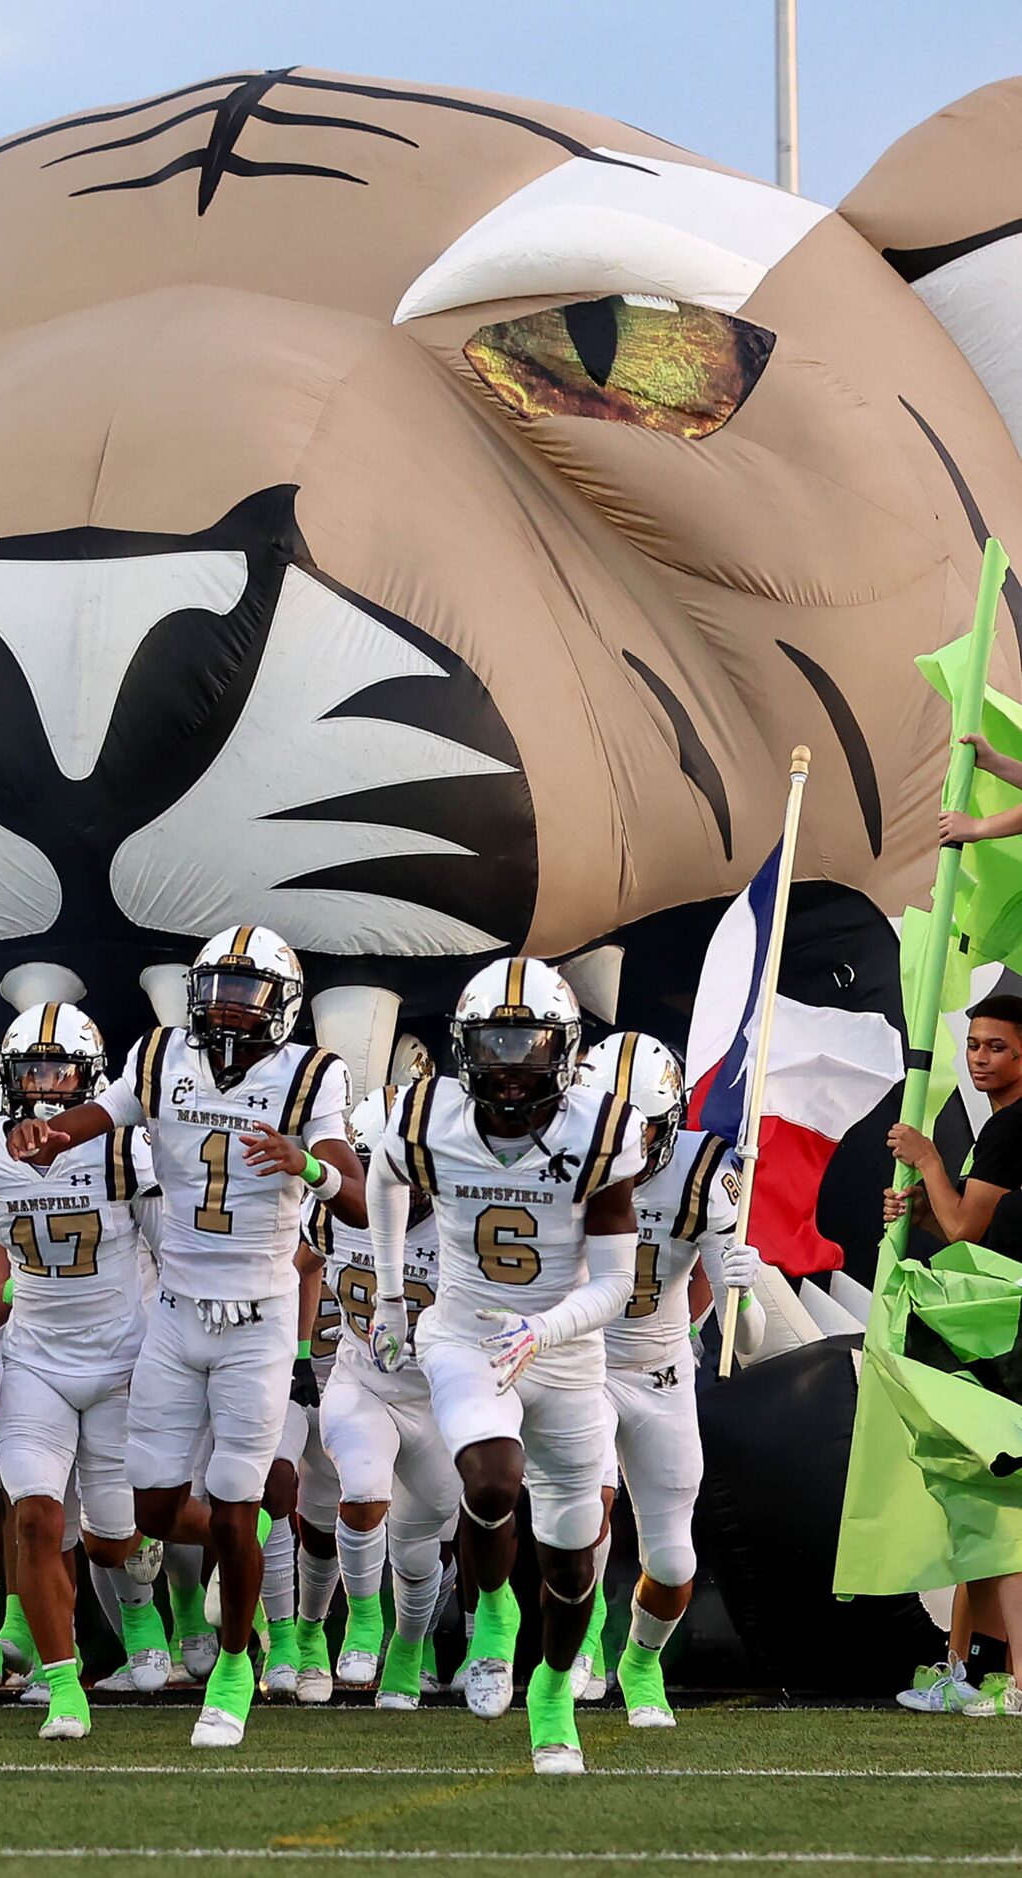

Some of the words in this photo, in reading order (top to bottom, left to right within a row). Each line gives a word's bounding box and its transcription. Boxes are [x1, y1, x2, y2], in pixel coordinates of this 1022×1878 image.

[171, 1086, 187, 1105] C
[177, 1109, 262, 1134] MANSFIEL
[194, 1129, 233, 1235] 1
[455, 1185, 554, 1205] MANSFIELD
[722, 1159, 744, 1206] 8
[6, 1195, 91, 1214] MANSFIELD
[10, 1208, 102, 1279] 17
[474, 1204, 542, 1285] 6
[650, 1364, 679, 1390] M
